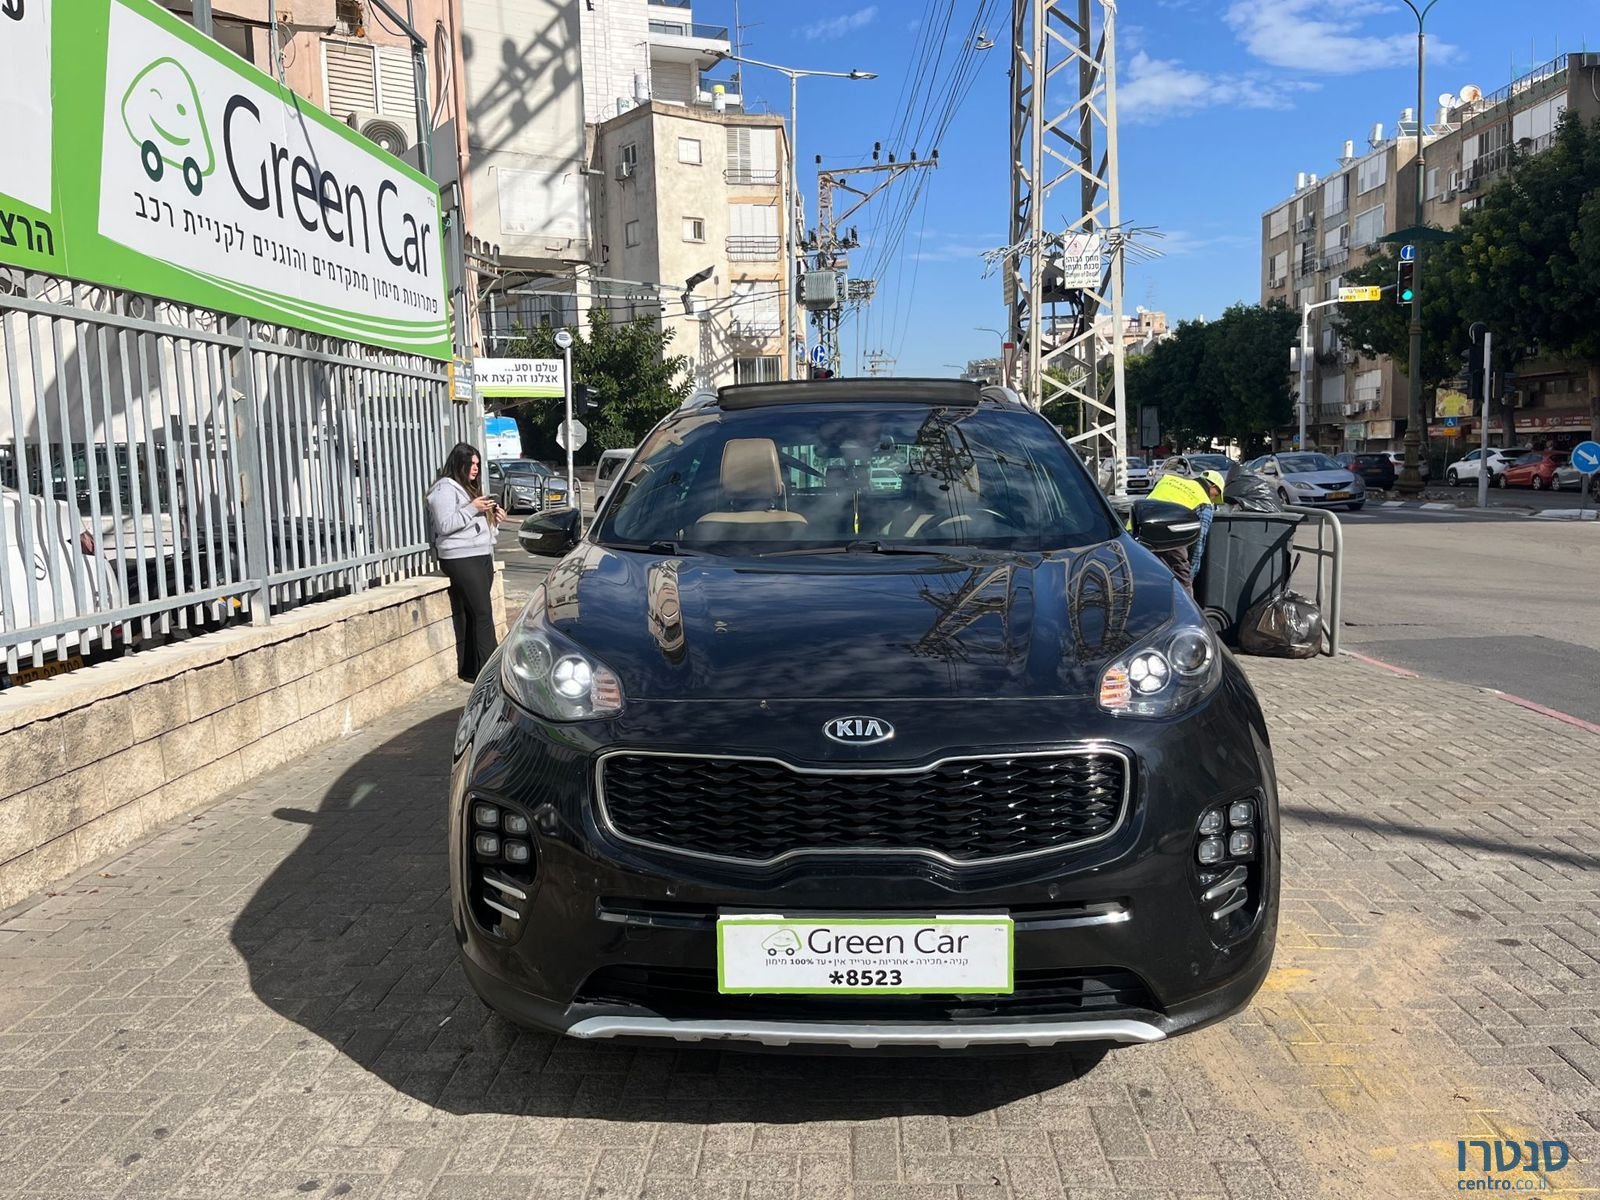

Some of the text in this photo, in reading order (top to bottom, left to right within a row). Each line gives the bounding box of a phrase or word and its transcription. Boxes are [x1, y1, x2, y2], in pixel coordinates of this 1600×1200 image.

[223, 94, 431, 278] Green Car
[134, 192, 438, 314] פתרונות מימון מתקדמים והוגנים לקניית רכב
[535, 362, 558, 372] שלם
[492, 374, 513, 384] קצת
[516, 374, 527, 383] זה
[530, 373, 558, 383] אצלנו
[836, 719, 883, 737] KIA
[807, 928, 969, 954] Green Car
[766, 958, 787, 967] מימון
[816, 958, 826, 966] עד
[834, 958, 846, 967] אין
[878, 958, 909, 966] אחריות
[949, 958, 968, 966] קניה
